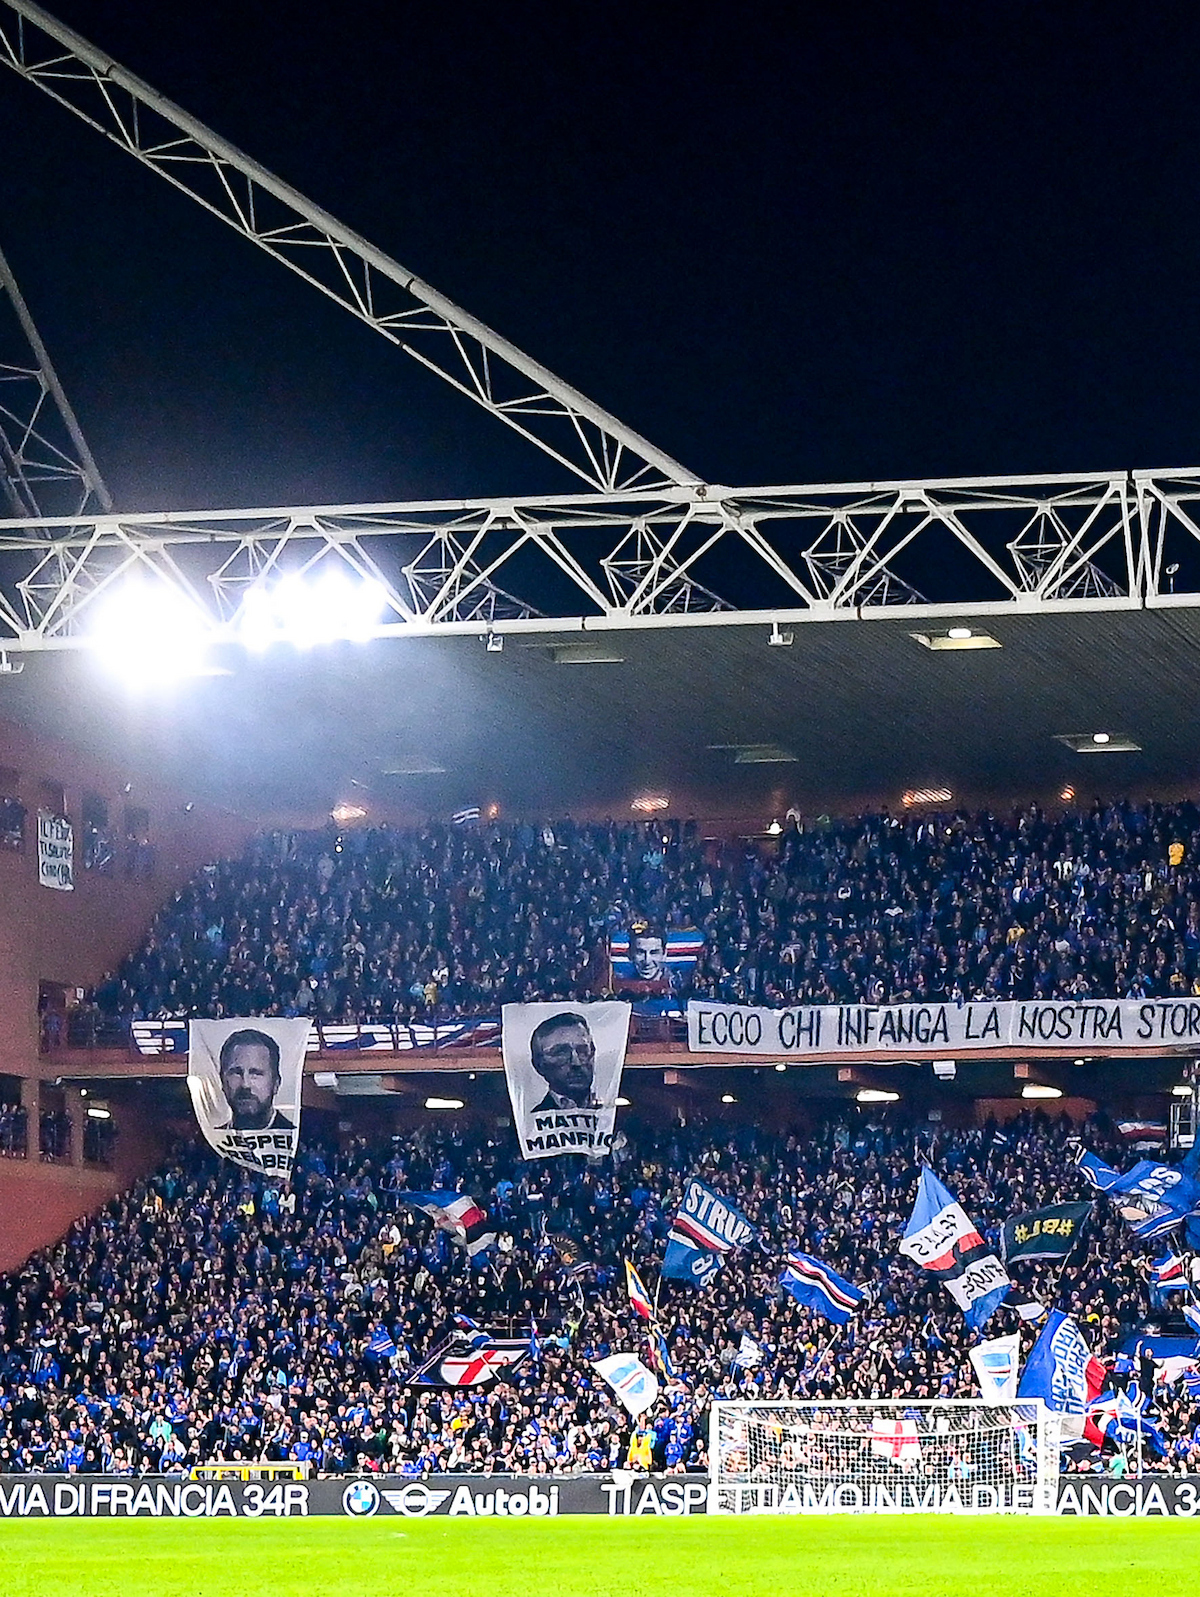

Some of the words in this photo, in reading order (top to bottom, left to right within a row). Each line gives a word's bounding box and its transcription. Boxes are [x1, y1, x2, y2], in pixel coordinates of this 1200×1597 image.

[698, 1011, 762, 1046] ECCO
[779, 1010, 820, 1048] CHI
[837, 1006, 949, 1045] INFANGA
[965, 1006, 1000, 1039] LA
[1018, 1005, 1122, 1040] NOSTRA
[0, 1483, 49, 1516] VIA
[54, 1484, 85, 1516] DI
[91, 1484, 237, 1516] FRANCIA
[242, 1484, 309, 1516] 34R
[449, 1485, 559, 1516] Autobi
